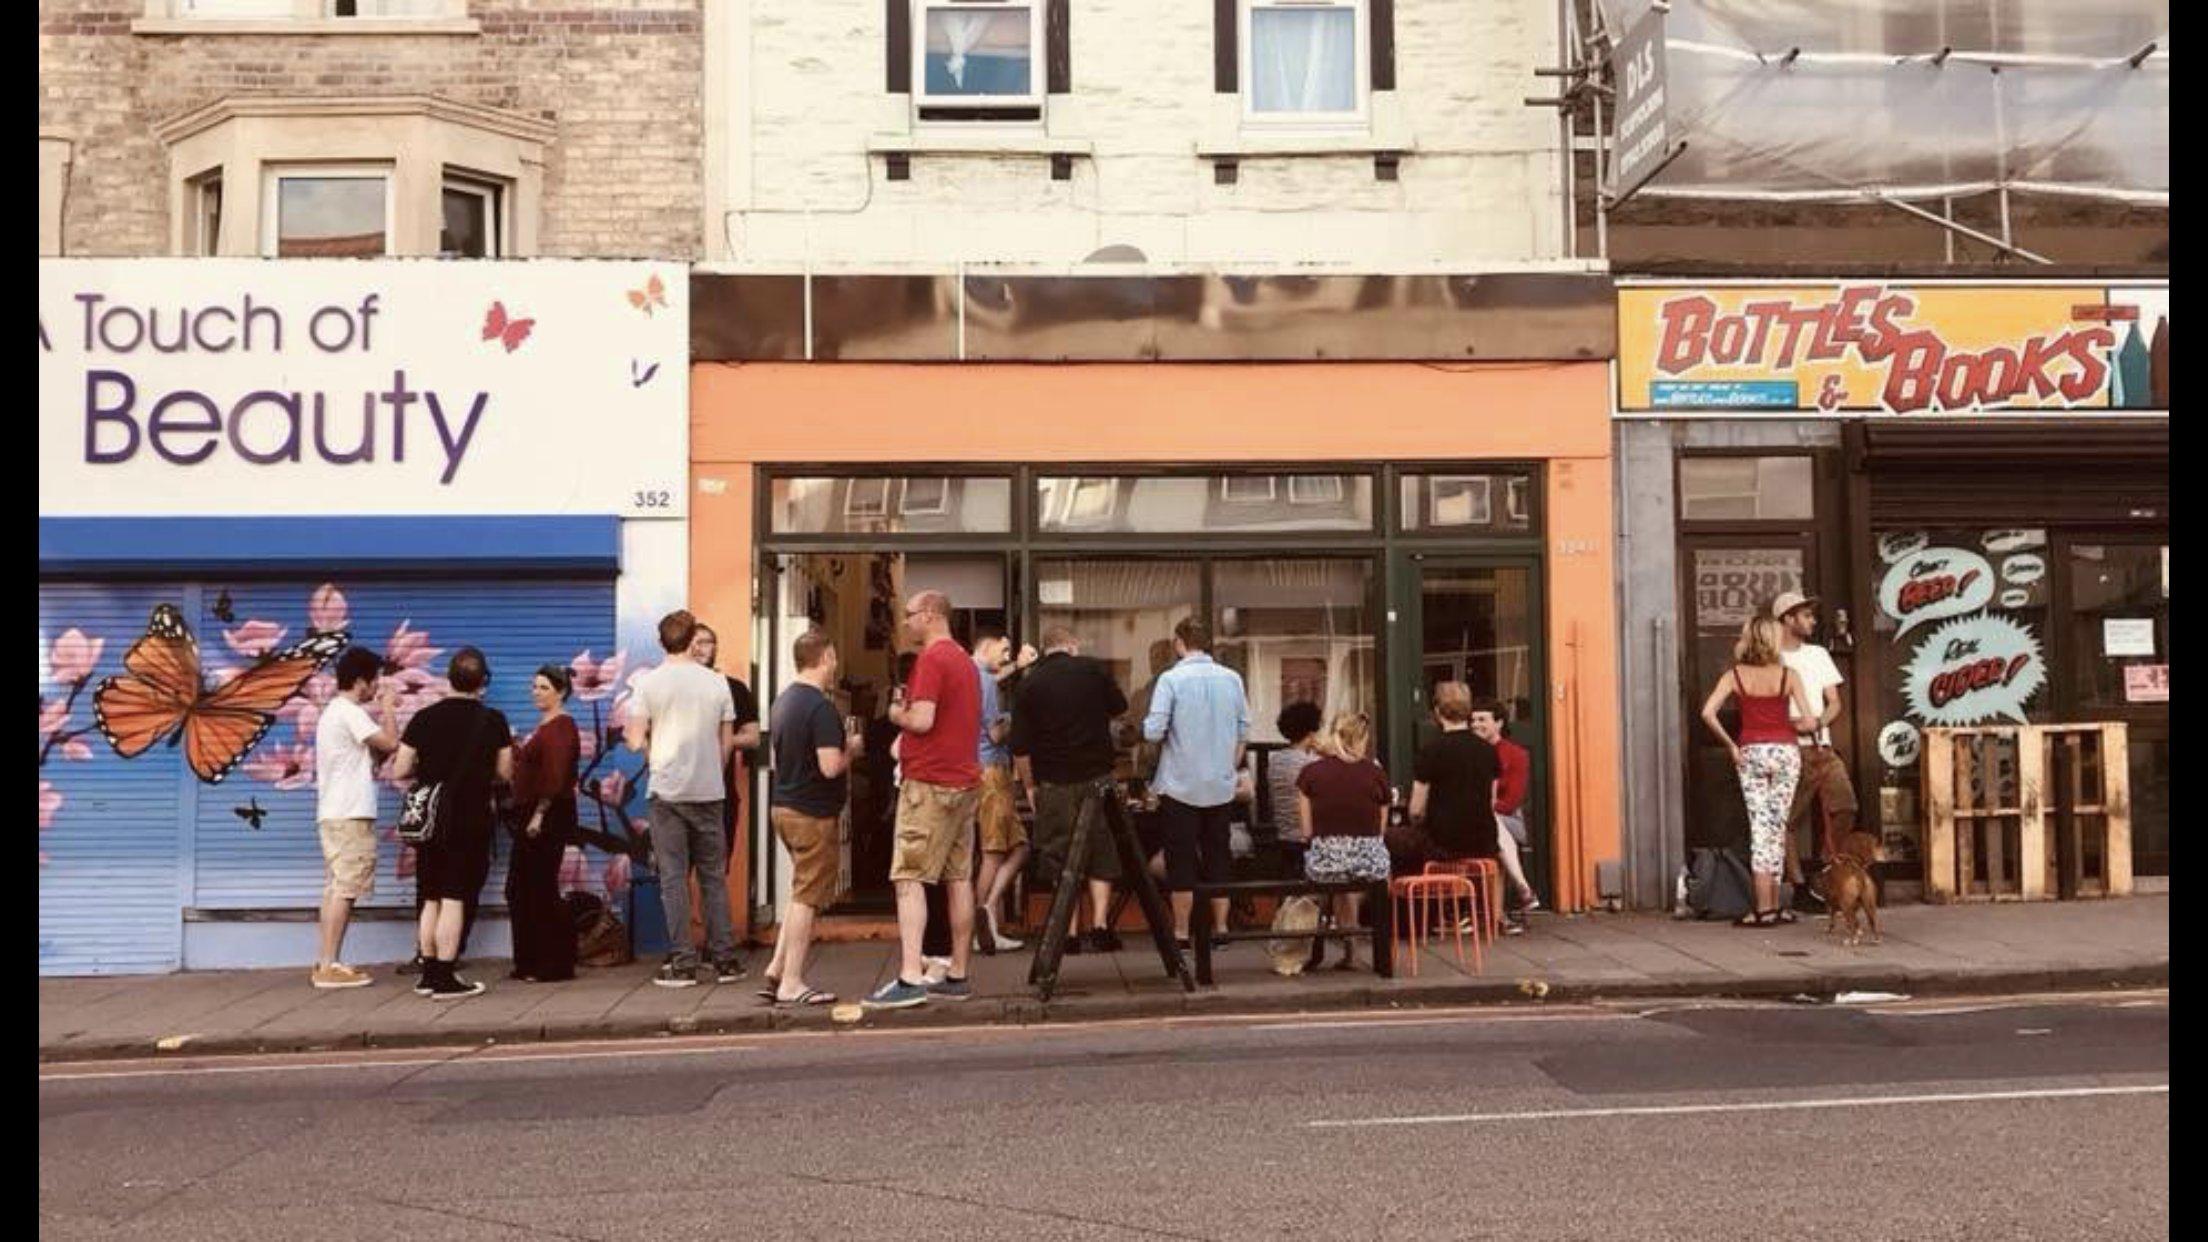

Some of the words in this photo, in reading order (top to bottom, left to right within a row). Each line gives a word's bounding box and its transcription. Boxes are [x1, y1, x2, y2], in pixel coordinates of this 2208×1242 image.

[1626, 39, 1655, 101] DLS
[75, 293, 282, 353] Touch
[309, 293, 379, 354] of
[1817, 374, 1849, 409] &
[1881, 329, 2116, 414] BOOKS
[84, 369, 489, 485] Beauty
[634, 491, 670, 508] 352
